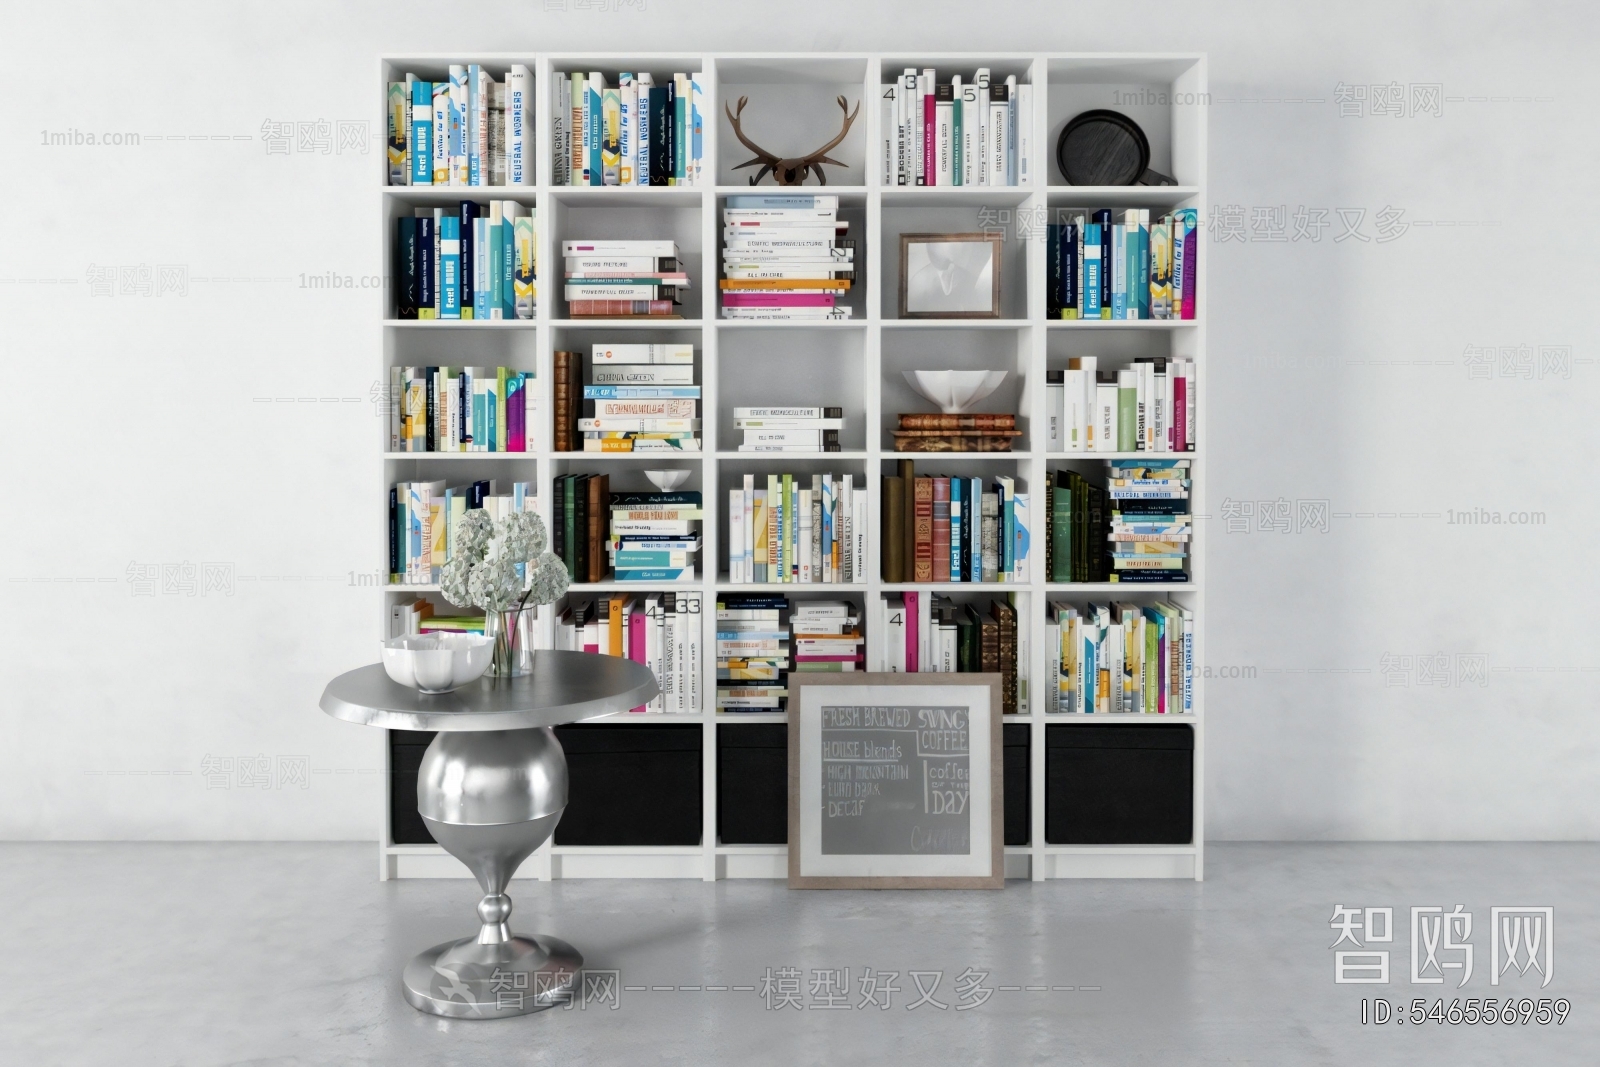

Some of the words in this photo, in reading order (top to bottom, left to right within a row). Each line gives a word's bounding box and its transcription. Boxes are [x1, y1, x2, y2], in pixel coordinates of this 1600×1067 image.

[905, 75, 917, 90] 3
[979, 74, 991, 88] 5
[883, 87, 896, 102] 4
[964, 88, 976, 102] 5
[513, 91, 522, 137] WORKERS
[513, 141, 522, 183] NEUTRAL
[676, 598, 688, 614] 3
[688, 598, 701, 614] 3
[889, 612, 903, 627] 4
[822, 707, 861, 728] FRESH
[864, 707, 911, 728] BREWED
[922, 730, 968, 751] COFFEE
[823, 741, 860, 758] HOUSE
